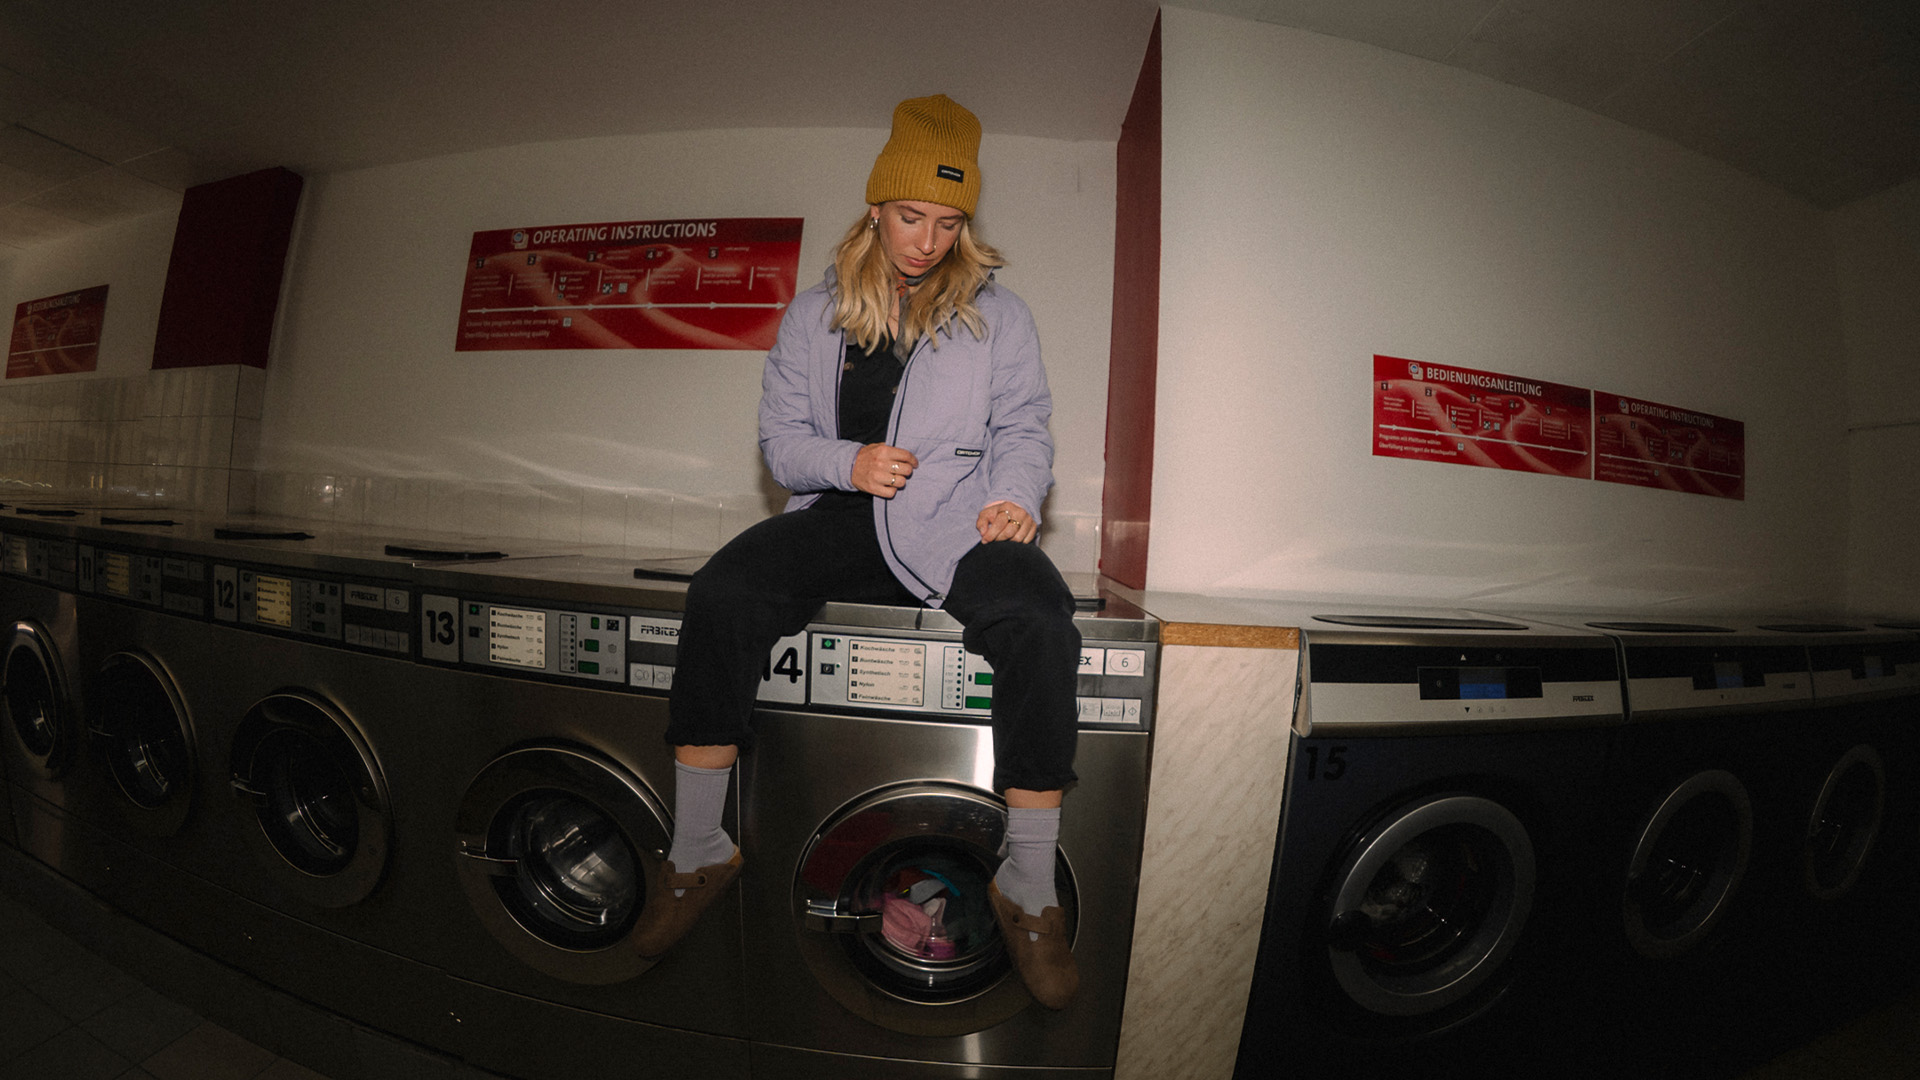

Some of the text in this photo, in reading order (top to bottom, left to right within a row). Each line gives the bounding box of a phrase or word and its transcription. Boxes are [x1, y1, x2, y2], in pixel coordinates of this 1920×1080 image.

[532, 222, 718, 245] OPERATING INSTRUCTIONS
[1426, 367, 1542, 397] BEDIENUNGSANLEITUNG
[1630, 402, 1714, 429] OPERATING INSTRUCTIONS
[82, 557, 91, 580] 11
[216, 579, 235, 608] 12
[426, 610, 455, 645] 13
[1121, 657, 1129, 668] 6
[1305, 746, 1348, 781] 15
